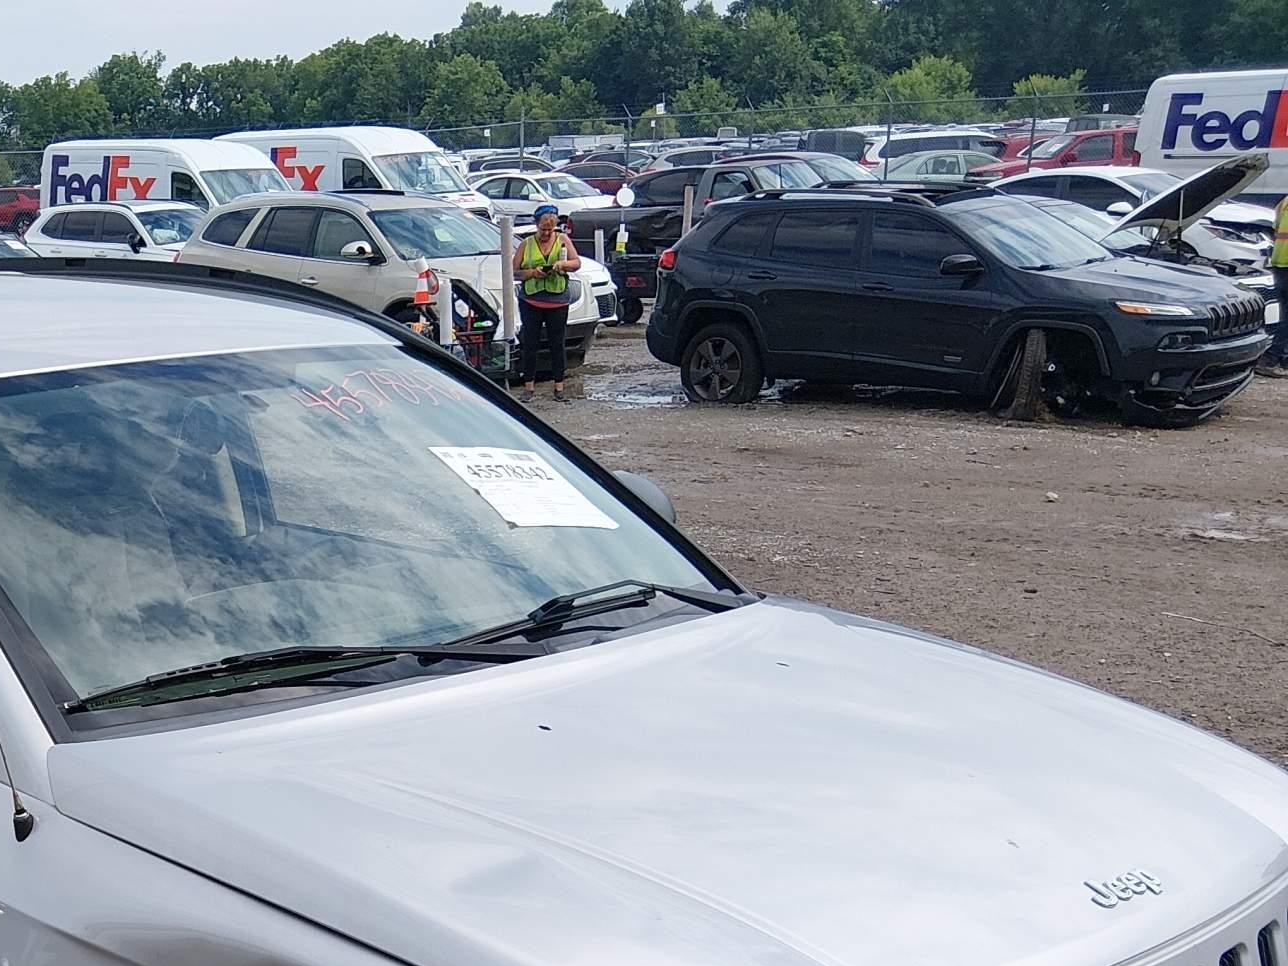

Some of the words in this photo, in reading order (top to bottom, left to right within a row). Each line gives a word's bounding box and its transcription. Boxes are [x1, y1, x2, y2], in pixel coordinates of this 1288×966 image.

[50, 154, 157, 207] FedEx
[466, 464, 554, 481] 45578342
[1083, 868, 1163, 909] Jeep
